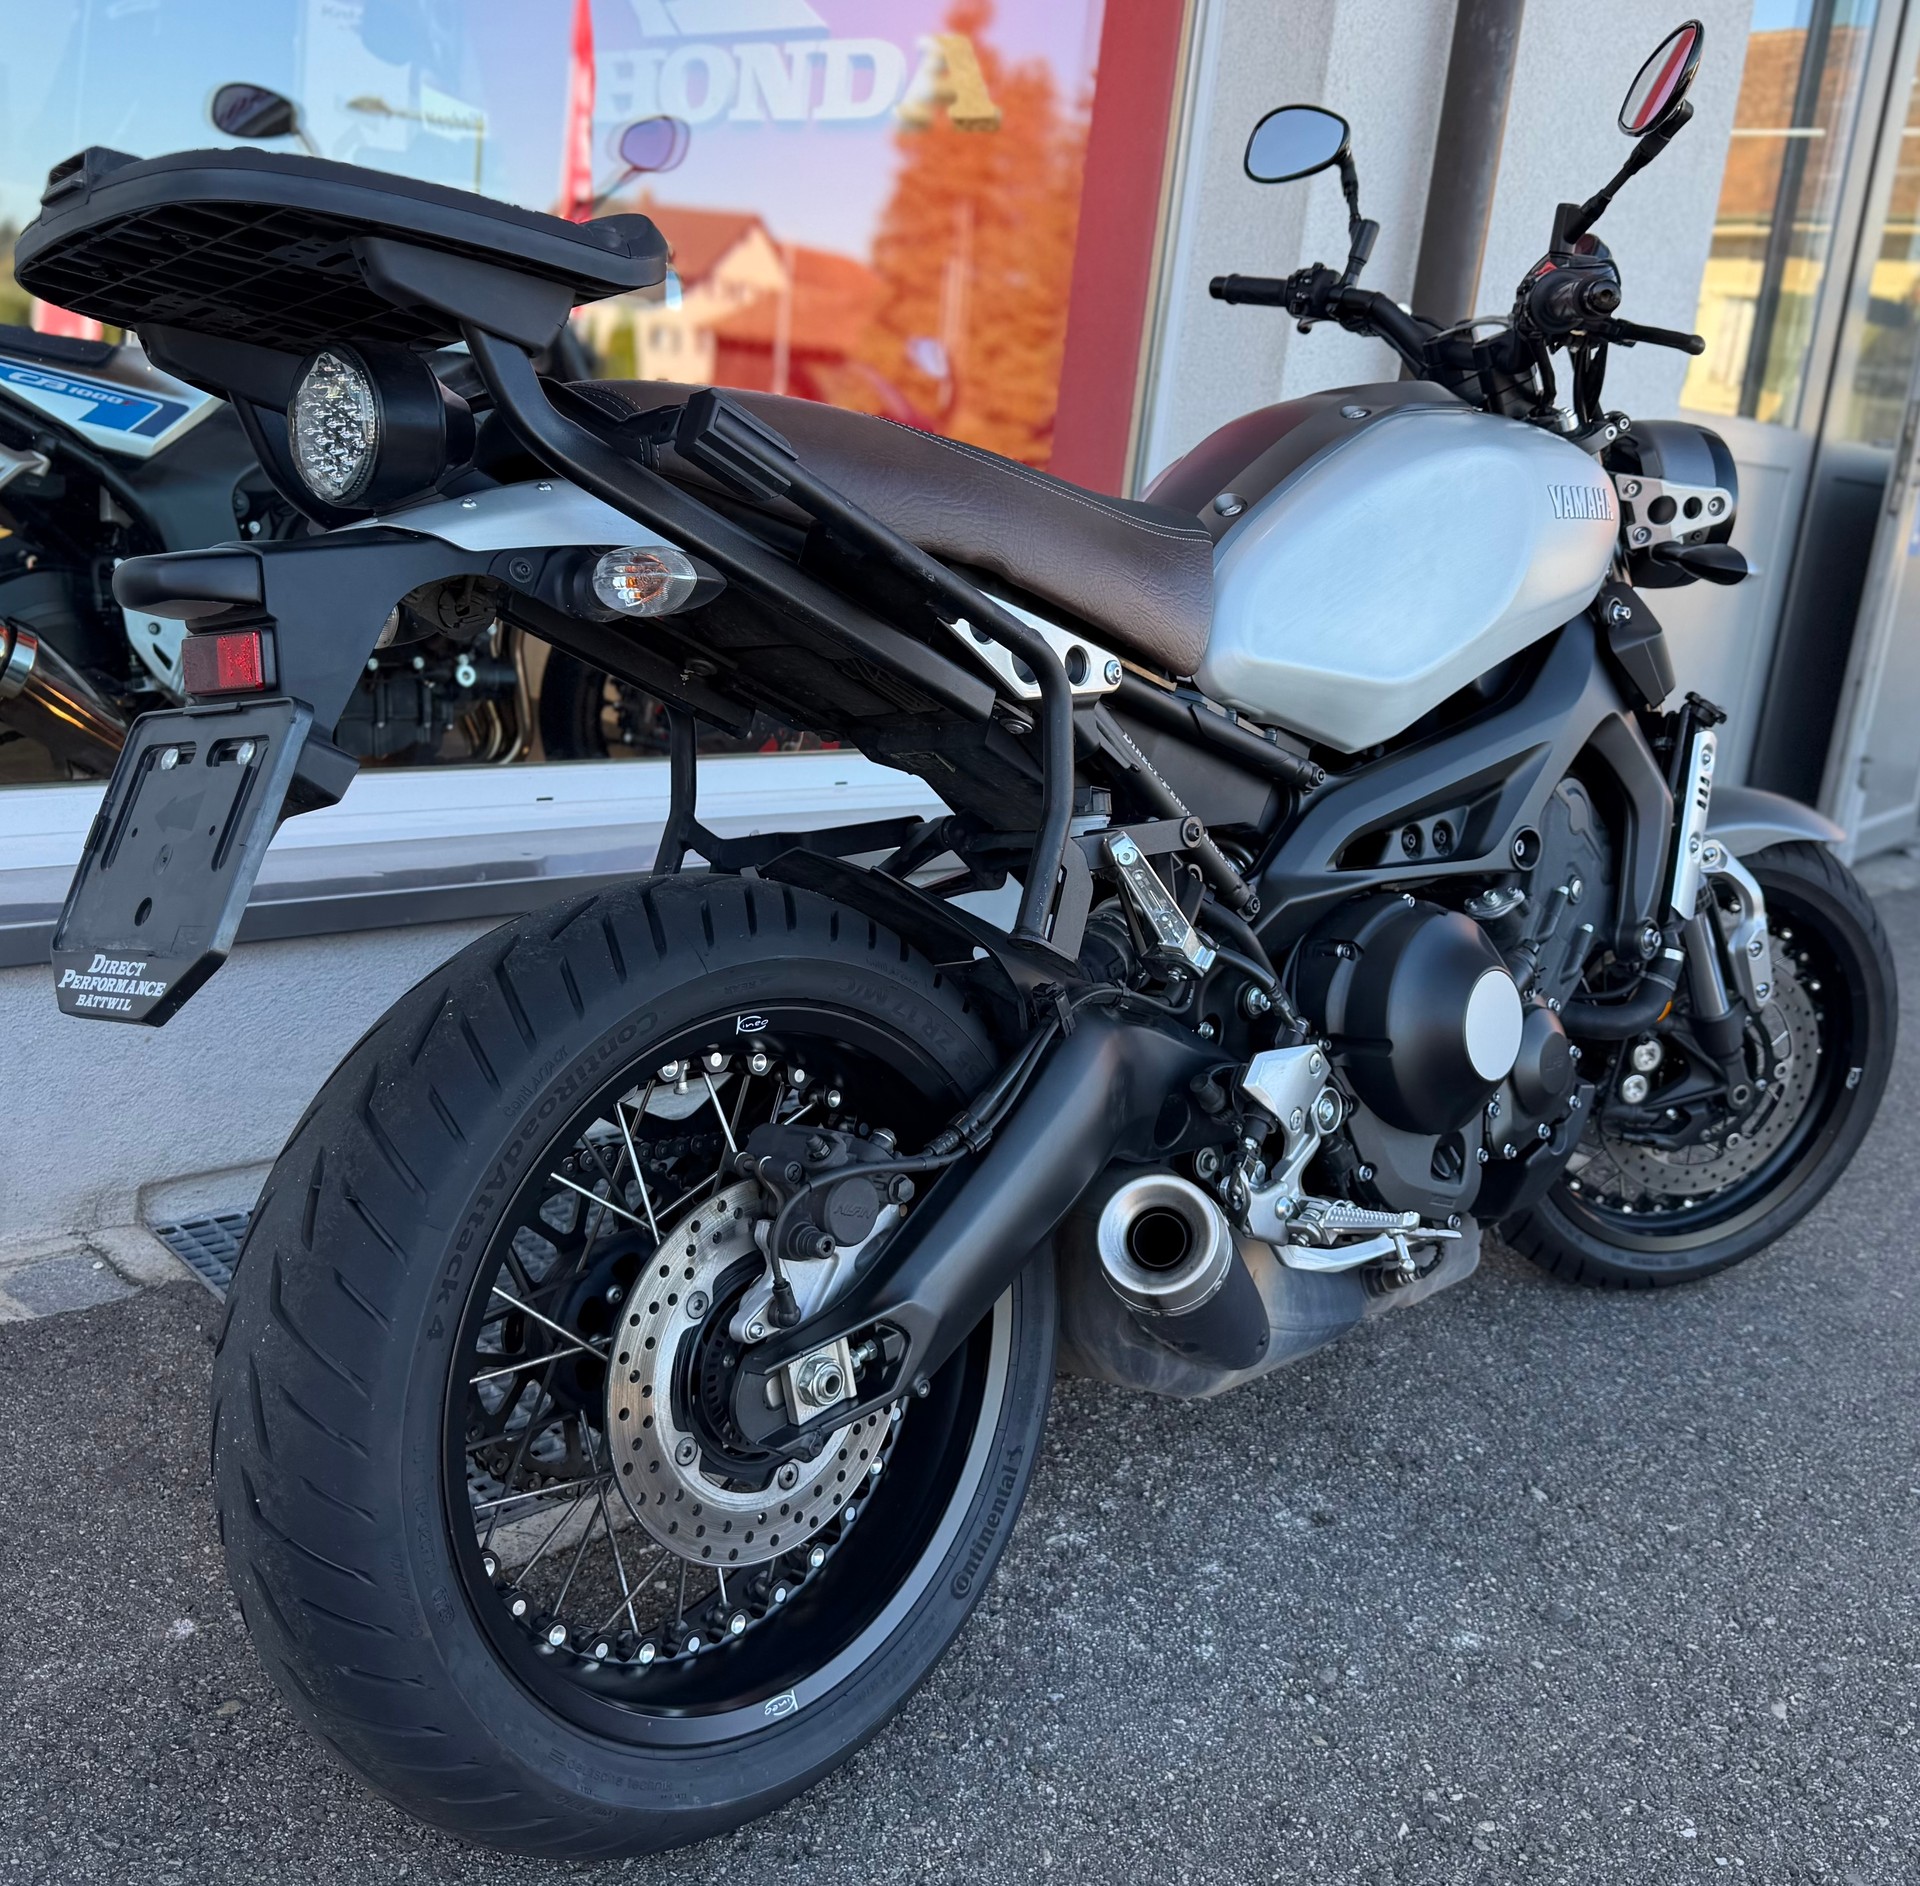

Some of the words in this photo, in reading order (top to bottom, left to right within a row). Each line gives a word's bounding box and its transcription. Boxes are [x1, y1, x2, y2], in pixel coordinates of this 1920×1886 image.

[594, 35, 1000, 130] HONDA
[1546, 484, 1614, 521] YAMAHA
[88, 954, 147, 977] DIRECT
[58, 969, 167, 997] PERFORMANCE
[75, 993, 132, 1012] BÄTTWIL
[735, 1015, 769, 1036] Kineo
[436, 1011, 659, 1306] ContiRoadAttack
[426, 1314, 446, 1342] 4
[950, 1462, 1019, 1600] Continental
[764, 1688, 799, 1717] Kineo
